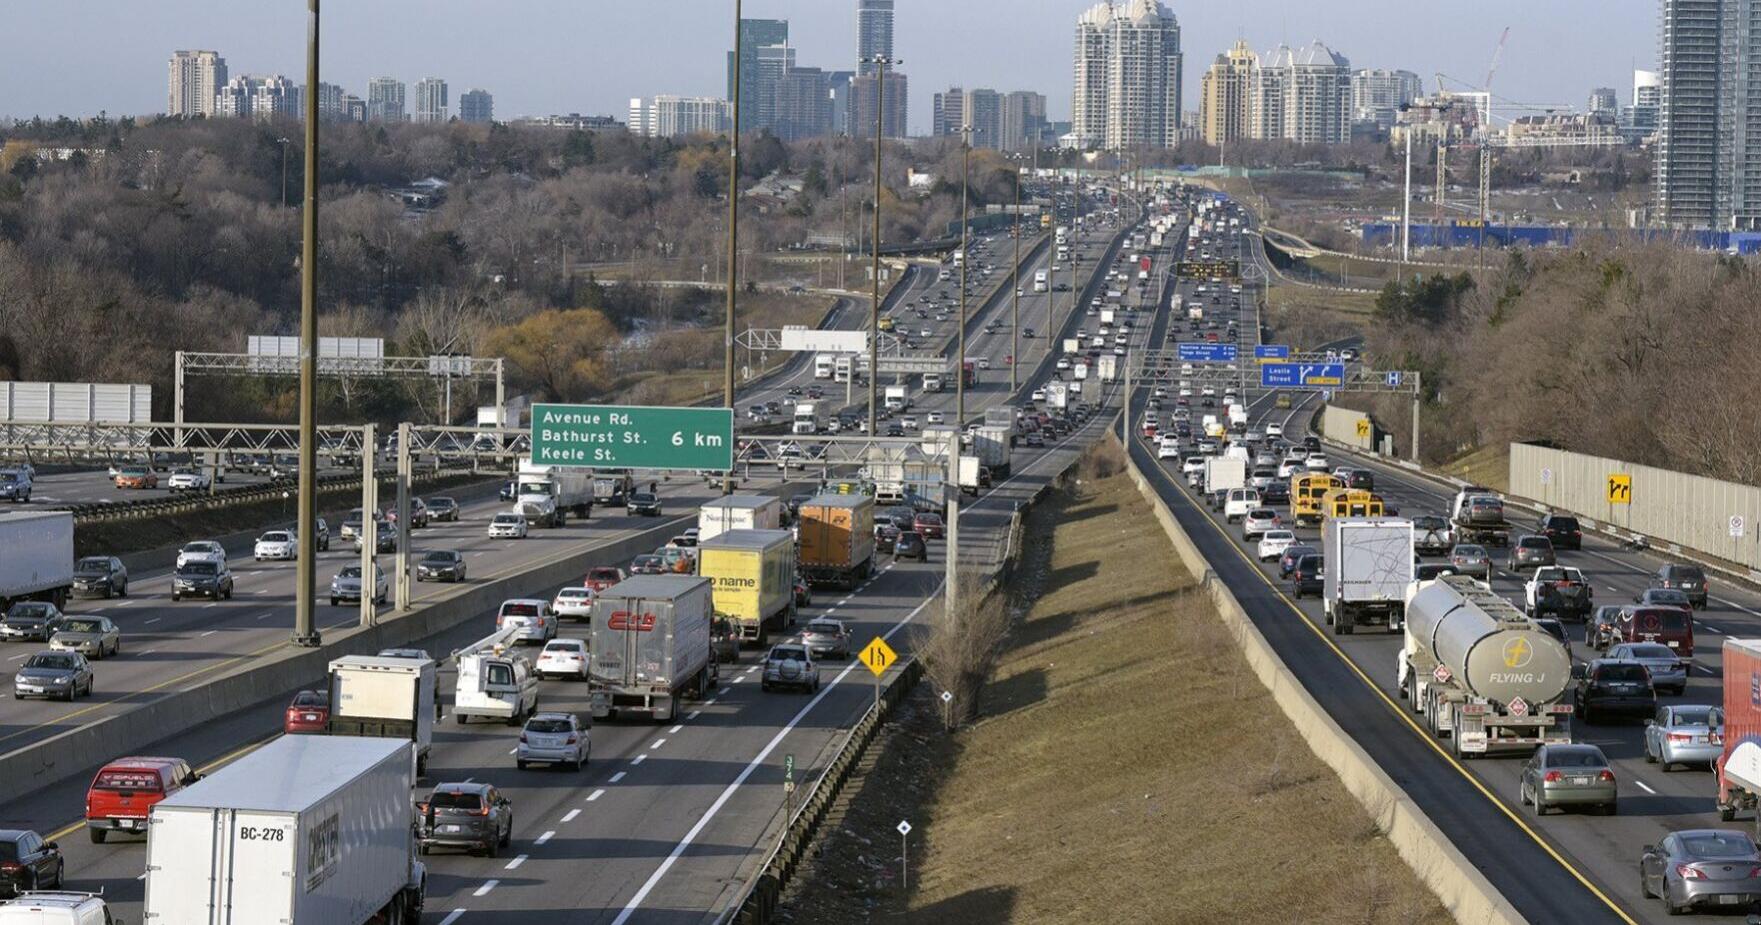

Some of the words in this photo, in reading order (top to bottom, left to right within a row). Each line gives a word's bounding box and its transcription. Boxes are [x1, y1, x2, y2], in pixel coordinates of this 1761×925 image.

[1268, 375, 1291, 383] Street
[543, 411, 601, 425] Avenue
[609, 413, 633, 425] Rd.
[541, 429, 614, 443] Bathurst
[623, 431, 648, 444] St.
[671, 431, 684, 446] 6
[694, 432, 722, 447] km
[541, 448, 585, 460] Keele
[594, 448, 616, 461] St.
[719, 576, 756, 588] name
[1489, 672, 1533, 684] FLYING
[1536, 672, 1546, 684] J
[240, 826, 285, 842] BC-278
